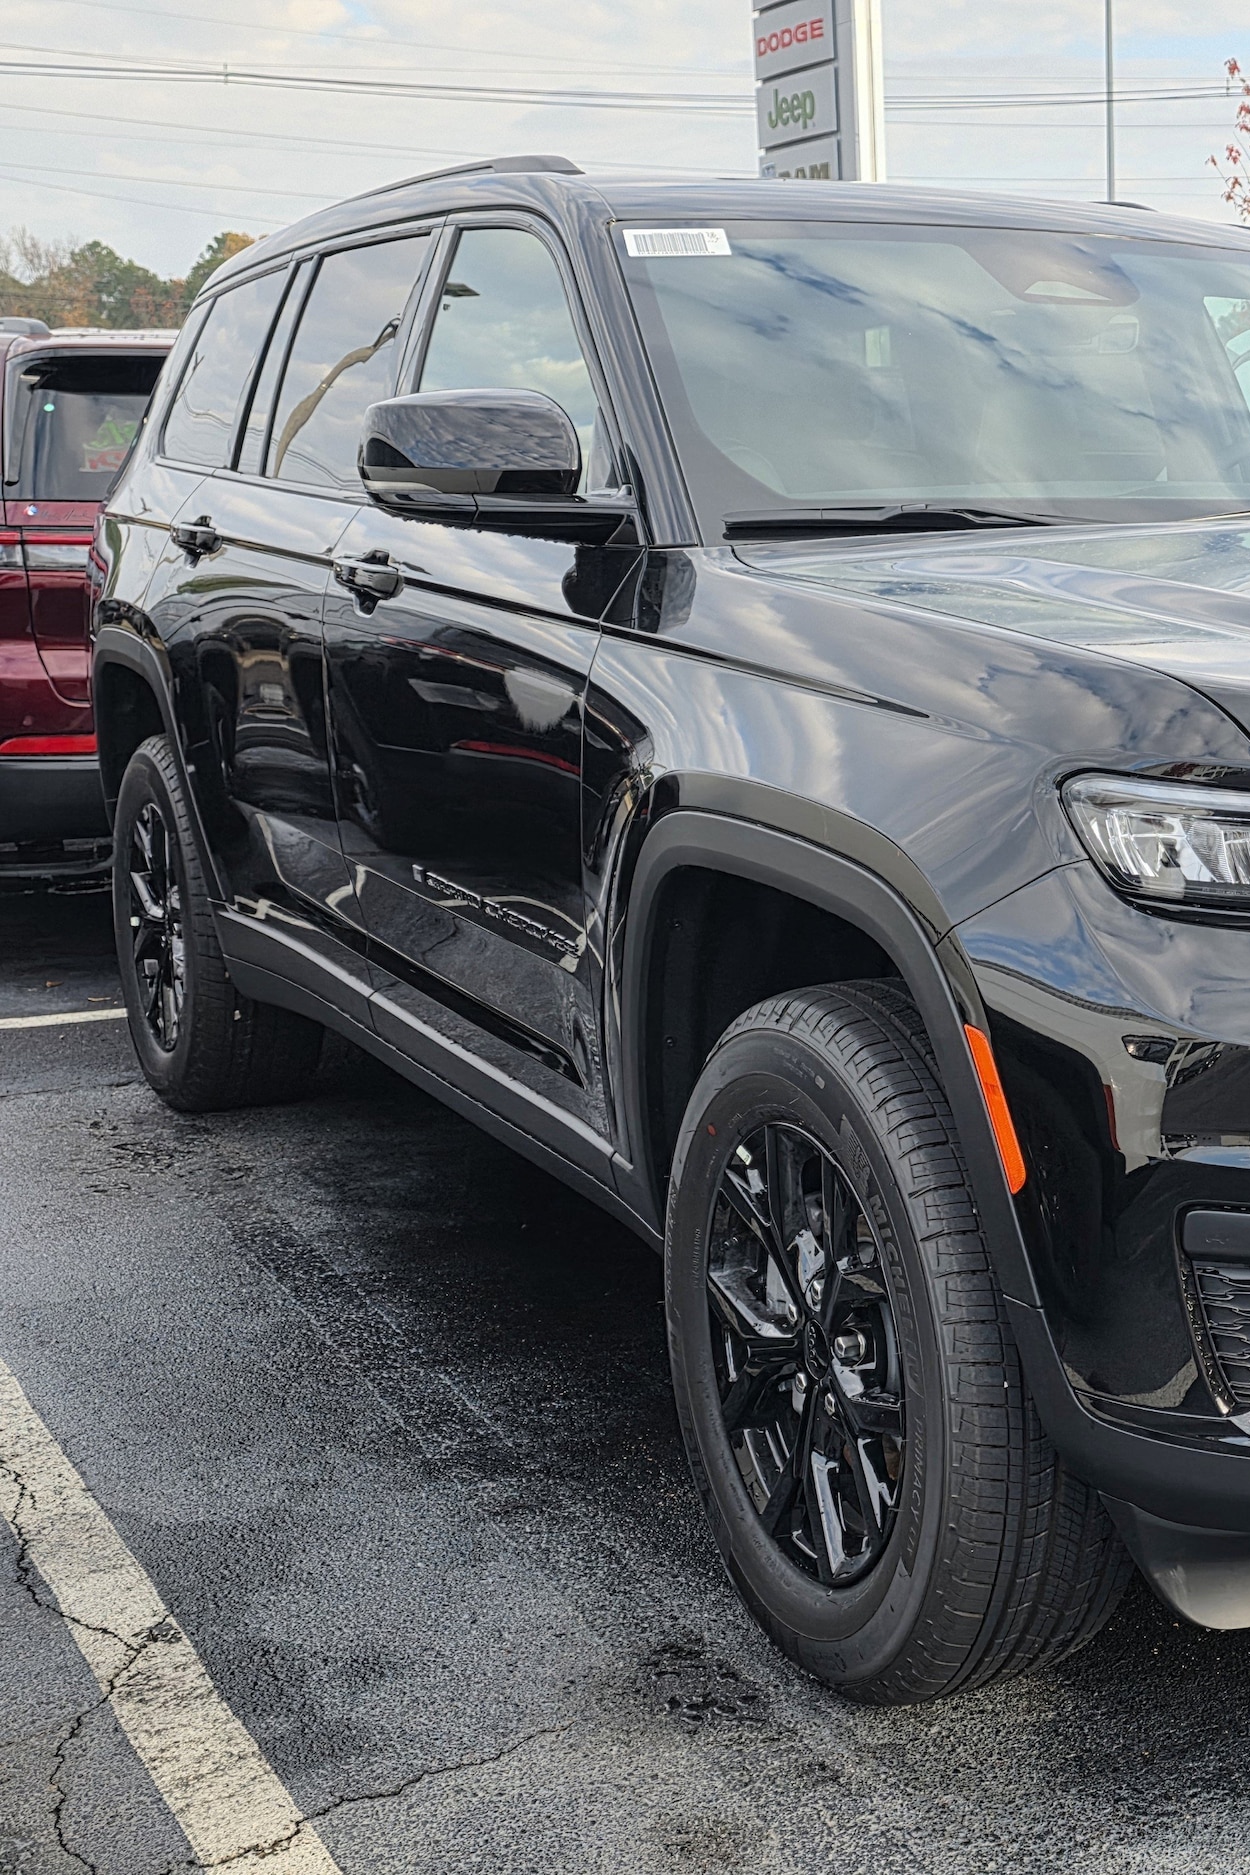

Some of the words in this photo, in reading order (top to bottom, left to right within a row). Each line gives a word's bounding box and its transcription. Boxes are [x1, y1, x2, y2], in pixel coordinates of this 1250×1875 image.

[757, 17, 824, 57] DODGE
[767, 88, 815, 129] Jeep
[869, 1194, 925, 1399] MICHELIN
[910, 1415, 925, 1526] PRIMACY
